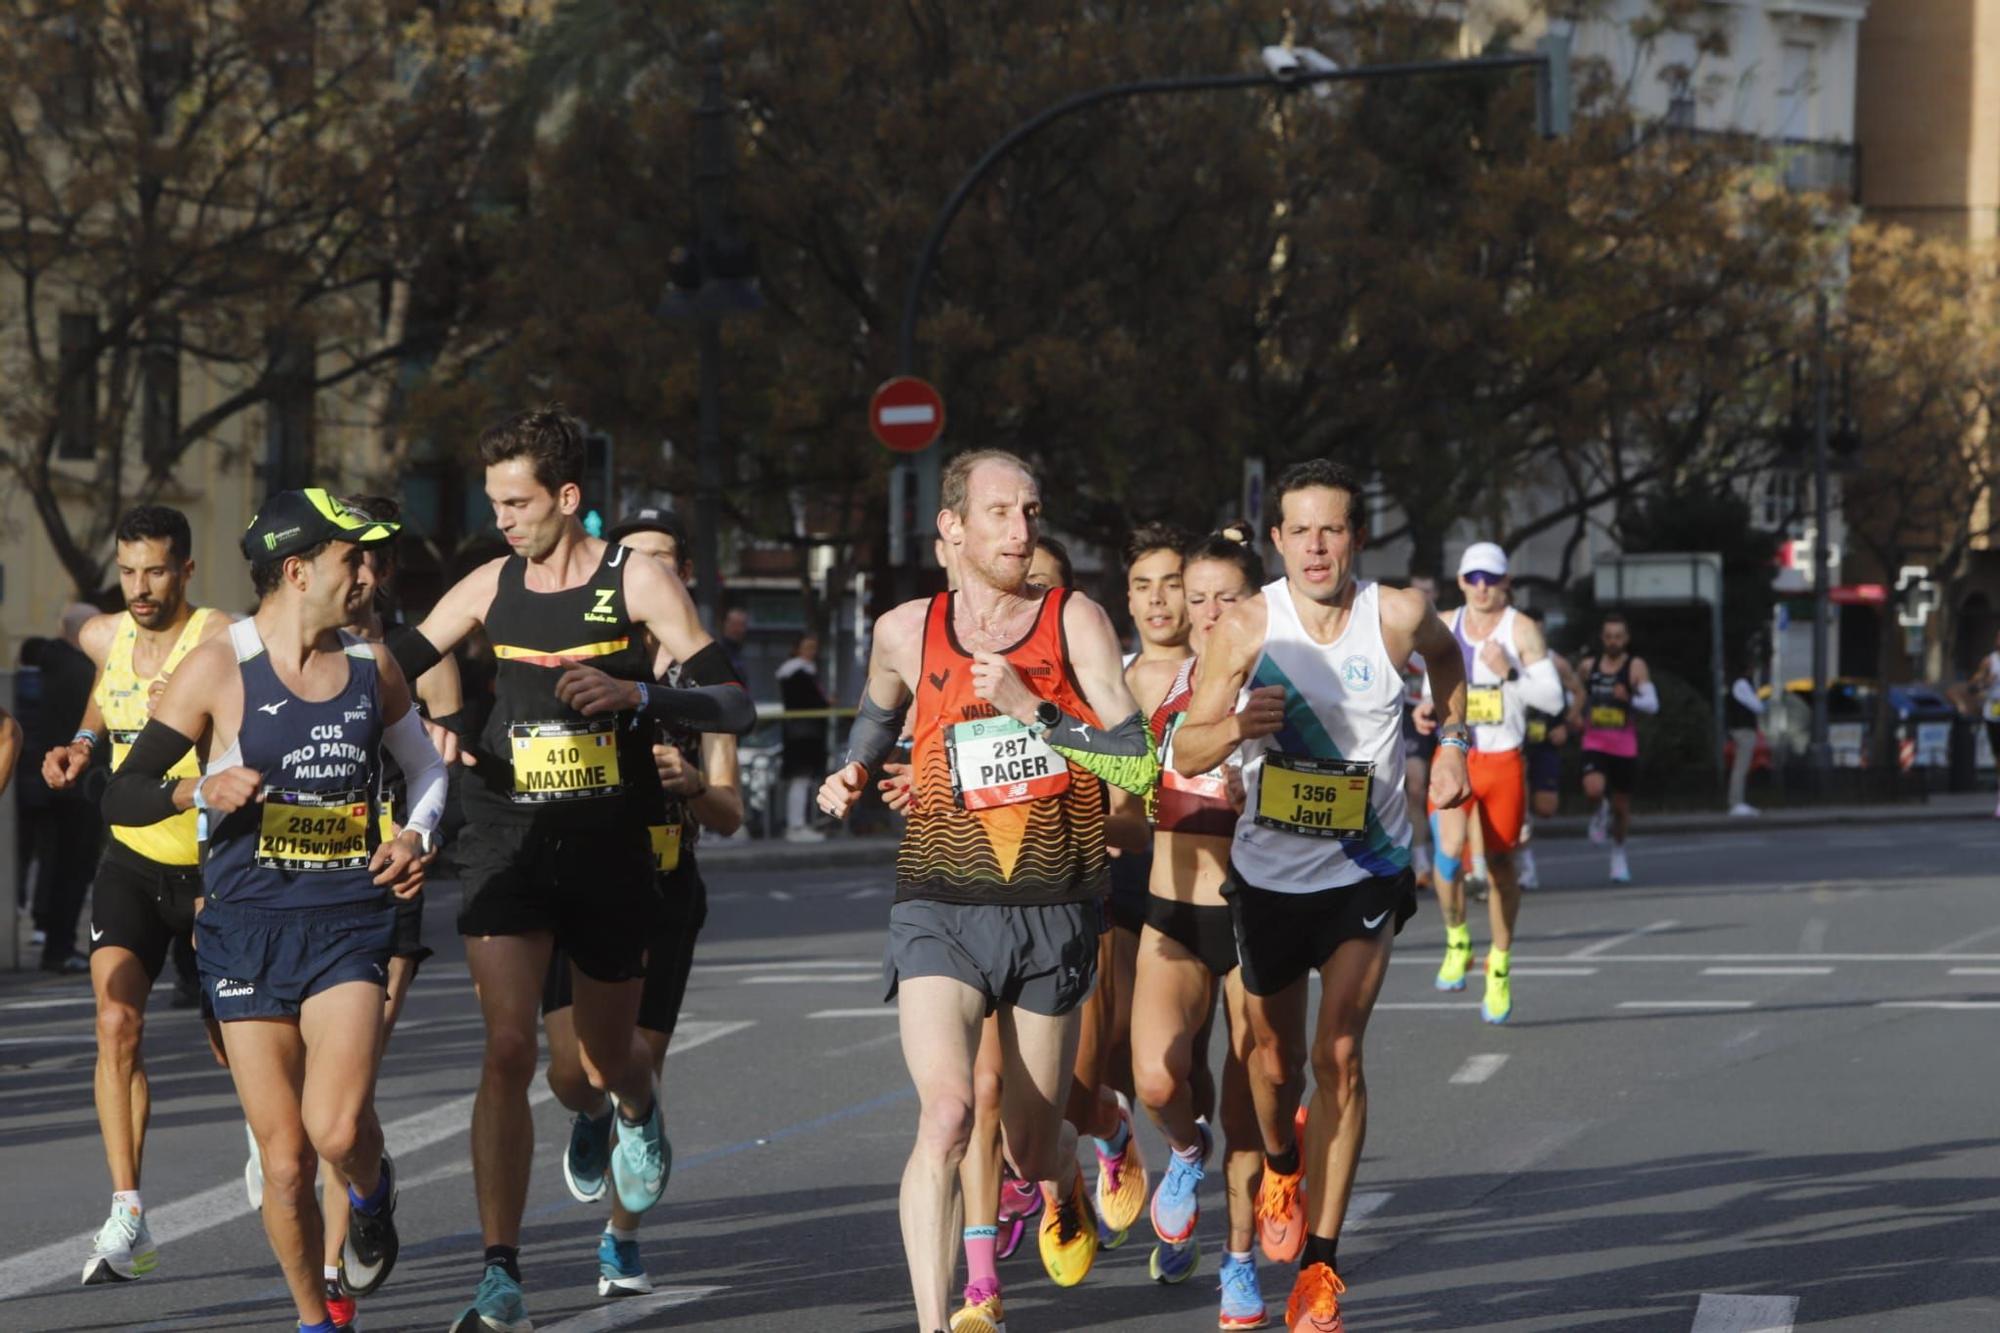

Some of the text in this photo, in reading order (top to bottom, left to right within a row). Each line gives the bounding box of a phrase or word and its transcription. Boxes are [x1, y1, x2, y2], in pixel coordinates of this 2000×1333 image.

[592, 589, 616, 614] Z
[344, 710, 367, 723] pwc
[310, 724, 343, 740] CUS
[282, 742, 367, 770] PRO PATRIA
[547, 747, 580, 765] 410
[992, 737, 1027, 759] 287
[295, 763, 356, 779] MILANO
[526, 766, 607, 790] MAXIME
[980, 756, 1049, 785] PACER
[1291, 783, 1337, 803] 1356
[1290, 804, 1333, 826] Javi
[288, 817, 346, 835] 28474
[262, 835, 363, 856] 2015win46
